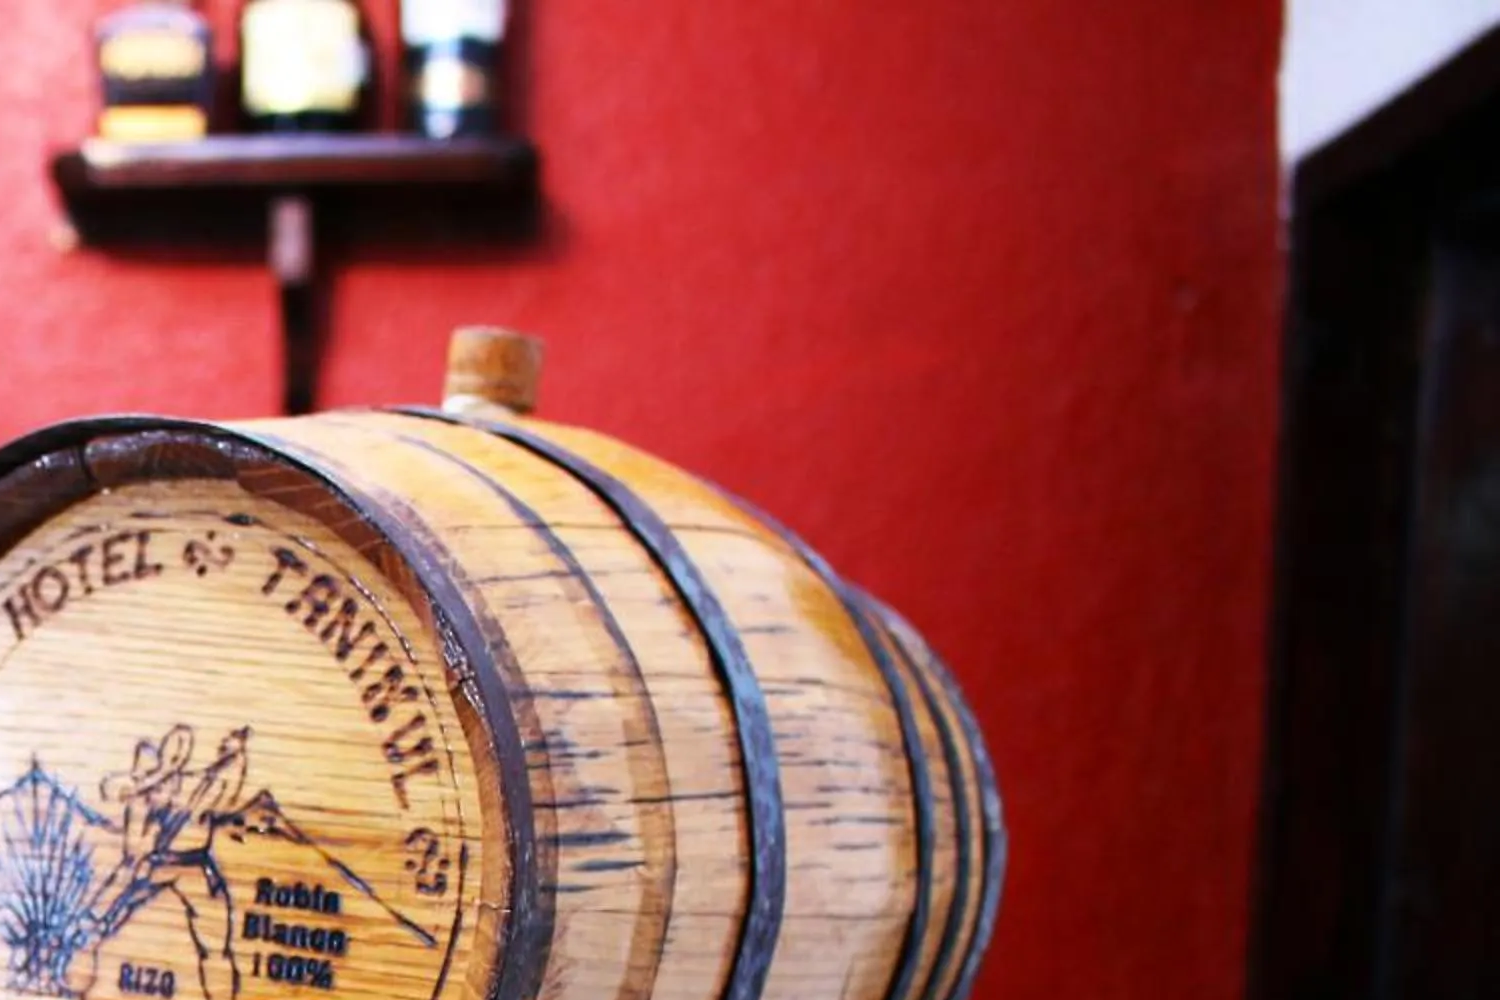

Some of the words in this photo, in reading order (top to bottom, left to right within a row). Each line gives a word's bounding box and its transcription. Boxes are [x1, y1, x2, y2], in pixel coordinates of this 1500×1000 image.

[2, 530, 163, 641] HOTEL
[242, 912, 347, 957] Blanco
[118, 962, 175, 1000] RIZO
[252, 952, 334, 989] 100%
